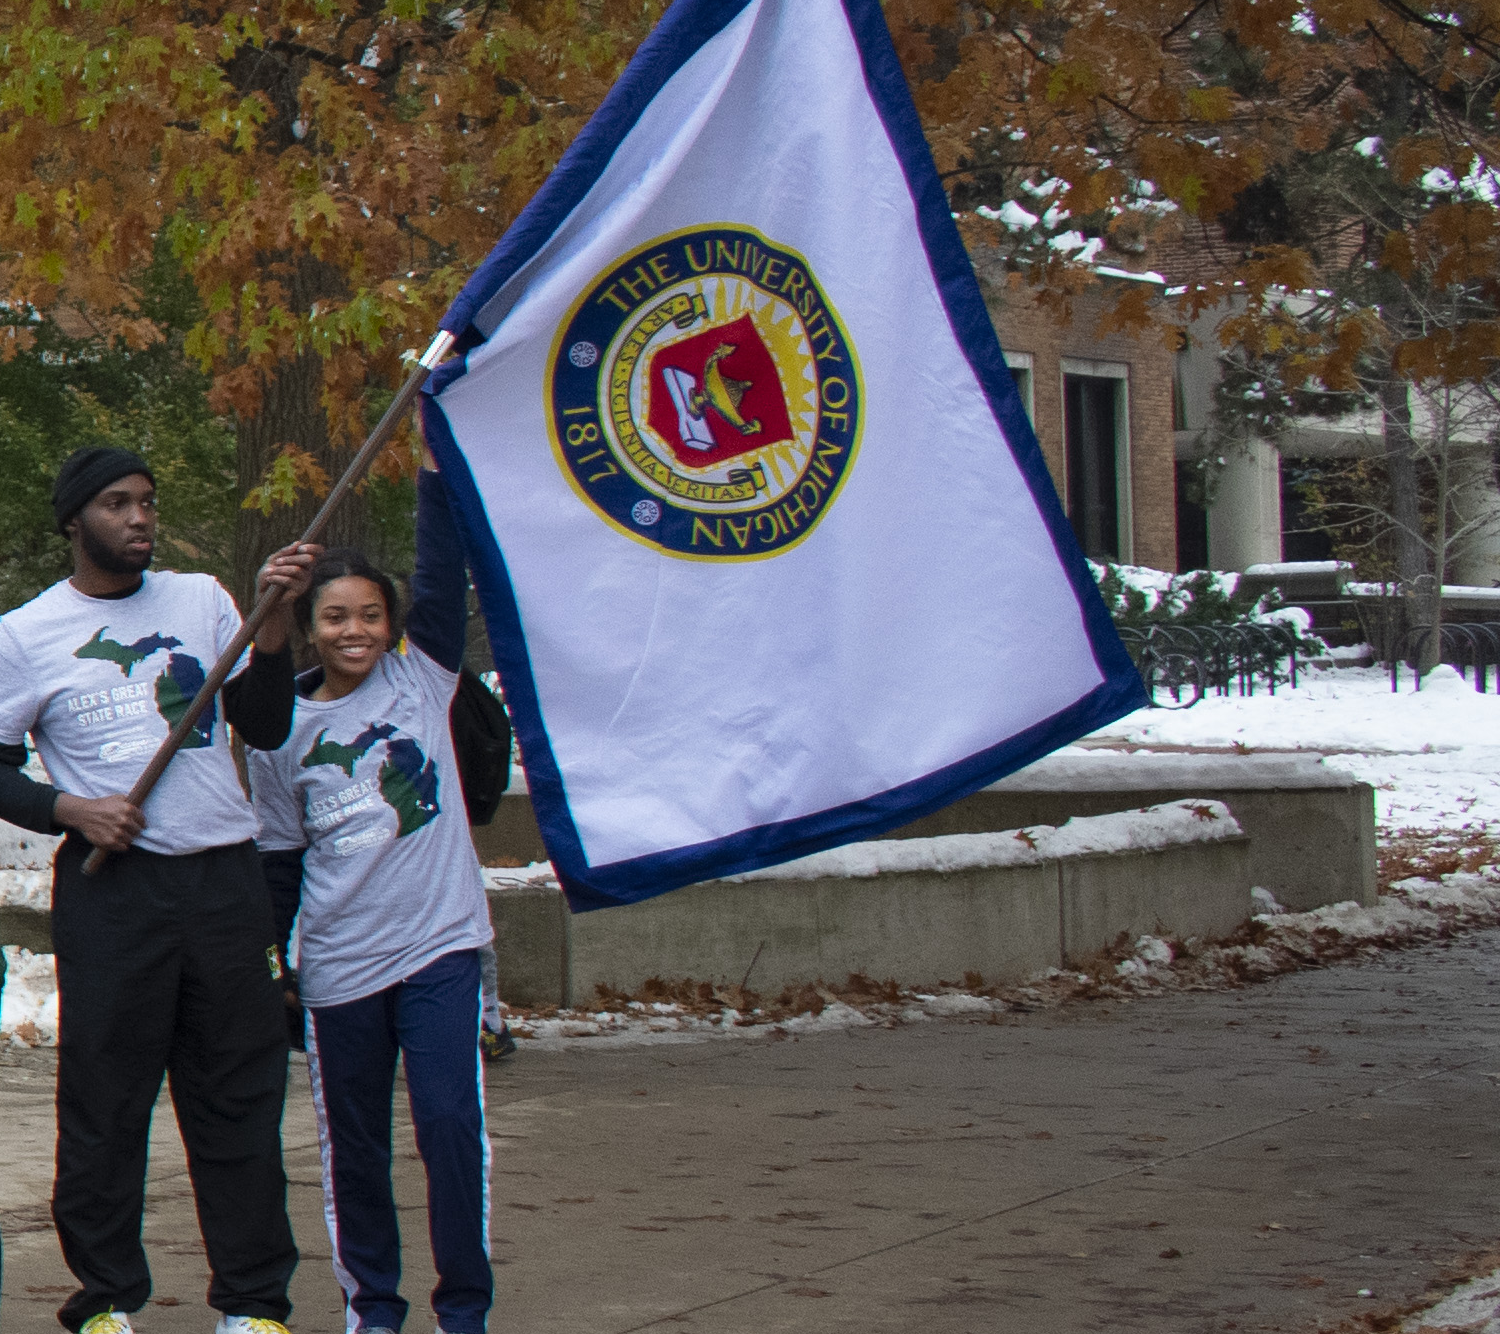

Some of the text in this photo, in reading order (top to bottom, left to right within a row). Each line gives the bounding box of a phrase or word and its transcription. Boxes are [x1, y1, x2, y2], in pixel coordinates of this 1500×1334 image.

[598, 239, 849, 548] THE UNIVERSITY OF MICHIGAN
[563, 406, 619, 483] 1817
[67, 682, 148, 712] ALEX'S GREAT
[77, 700, 148, 727] STATE RACE
